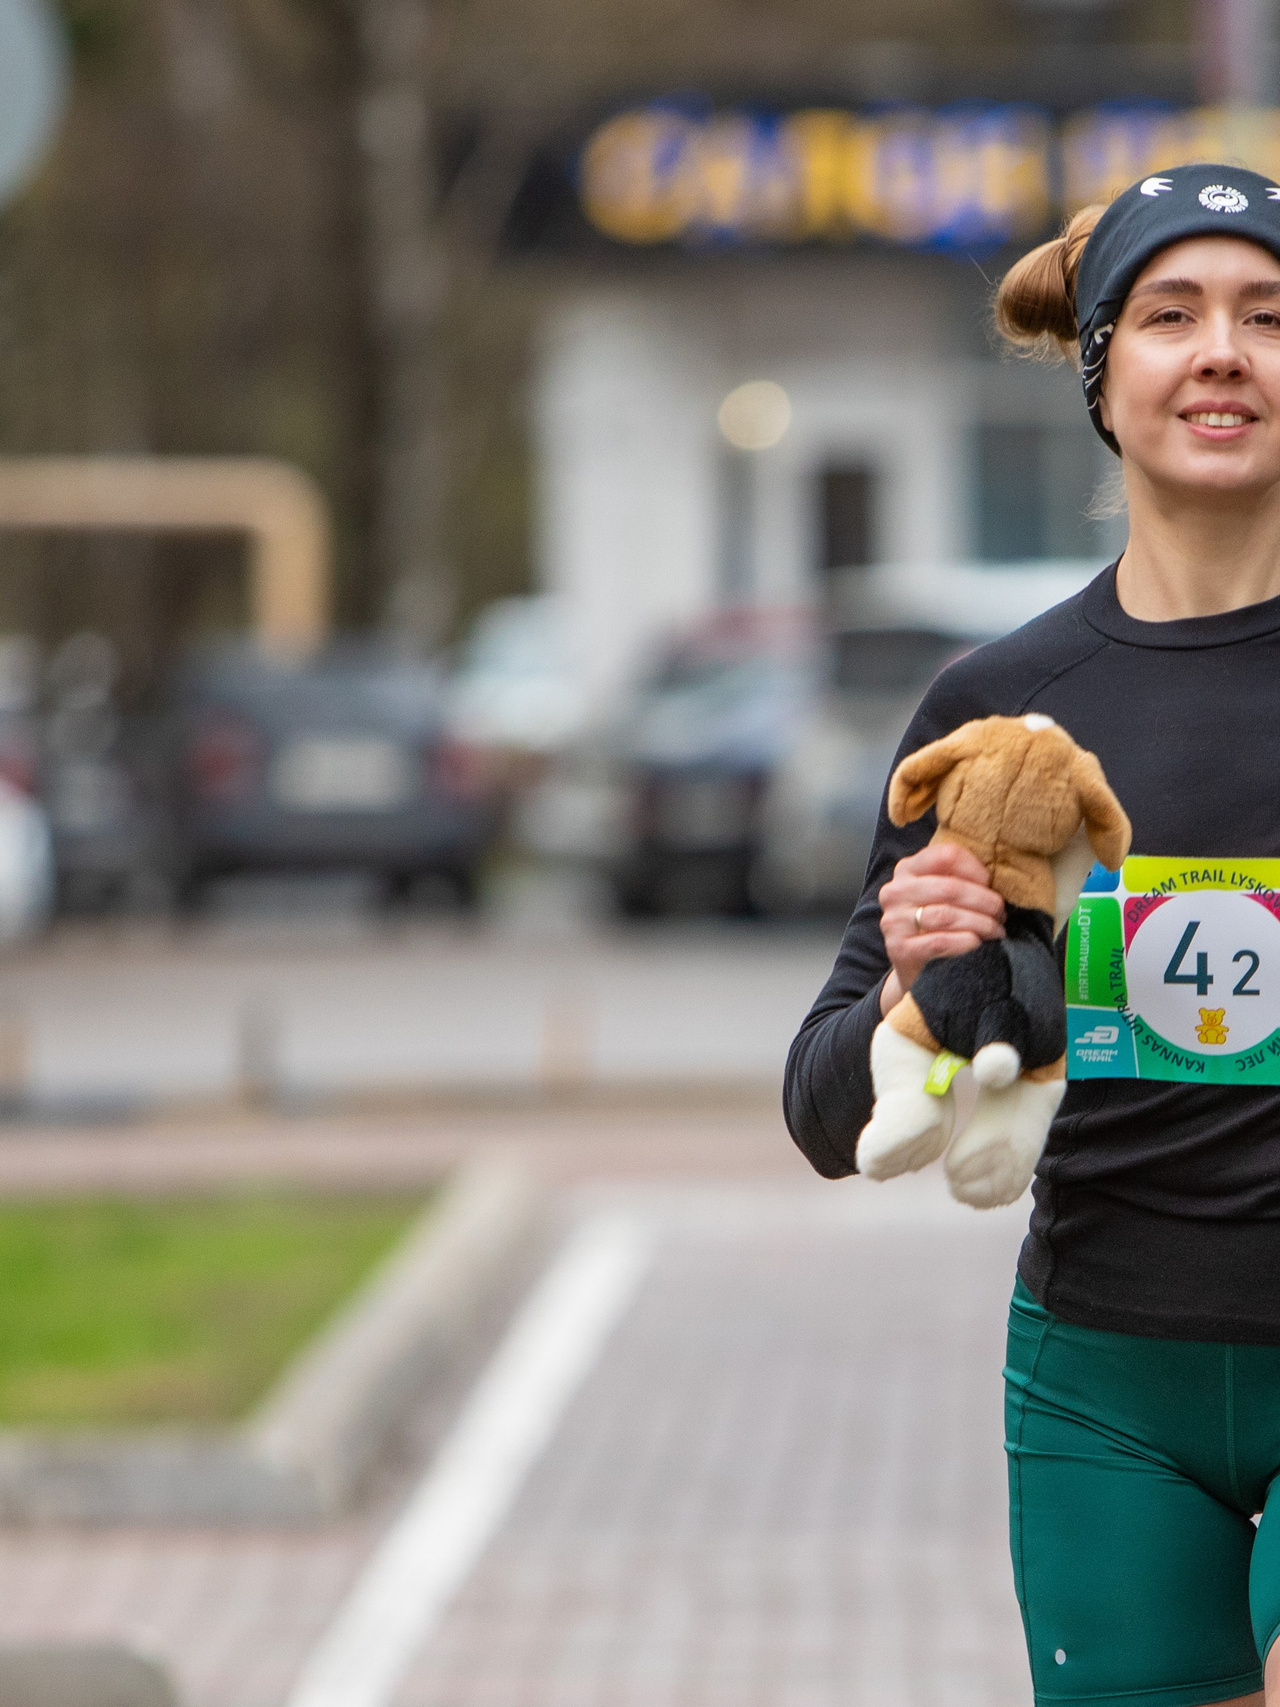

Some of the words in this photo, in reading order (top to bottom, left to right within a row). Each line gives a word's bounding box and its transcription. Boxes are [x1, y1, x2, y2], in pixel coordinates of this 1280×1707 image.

[1126, 877, 1177, 923] DREAM
[1179, 869, 1226, 886] TRAIL
[1109, 946, 1125, 991] TRAIL
[1141, 1034, 1205, 1074] KANNAS
[1234, 1049, 1266, 1072] ЛЕС
